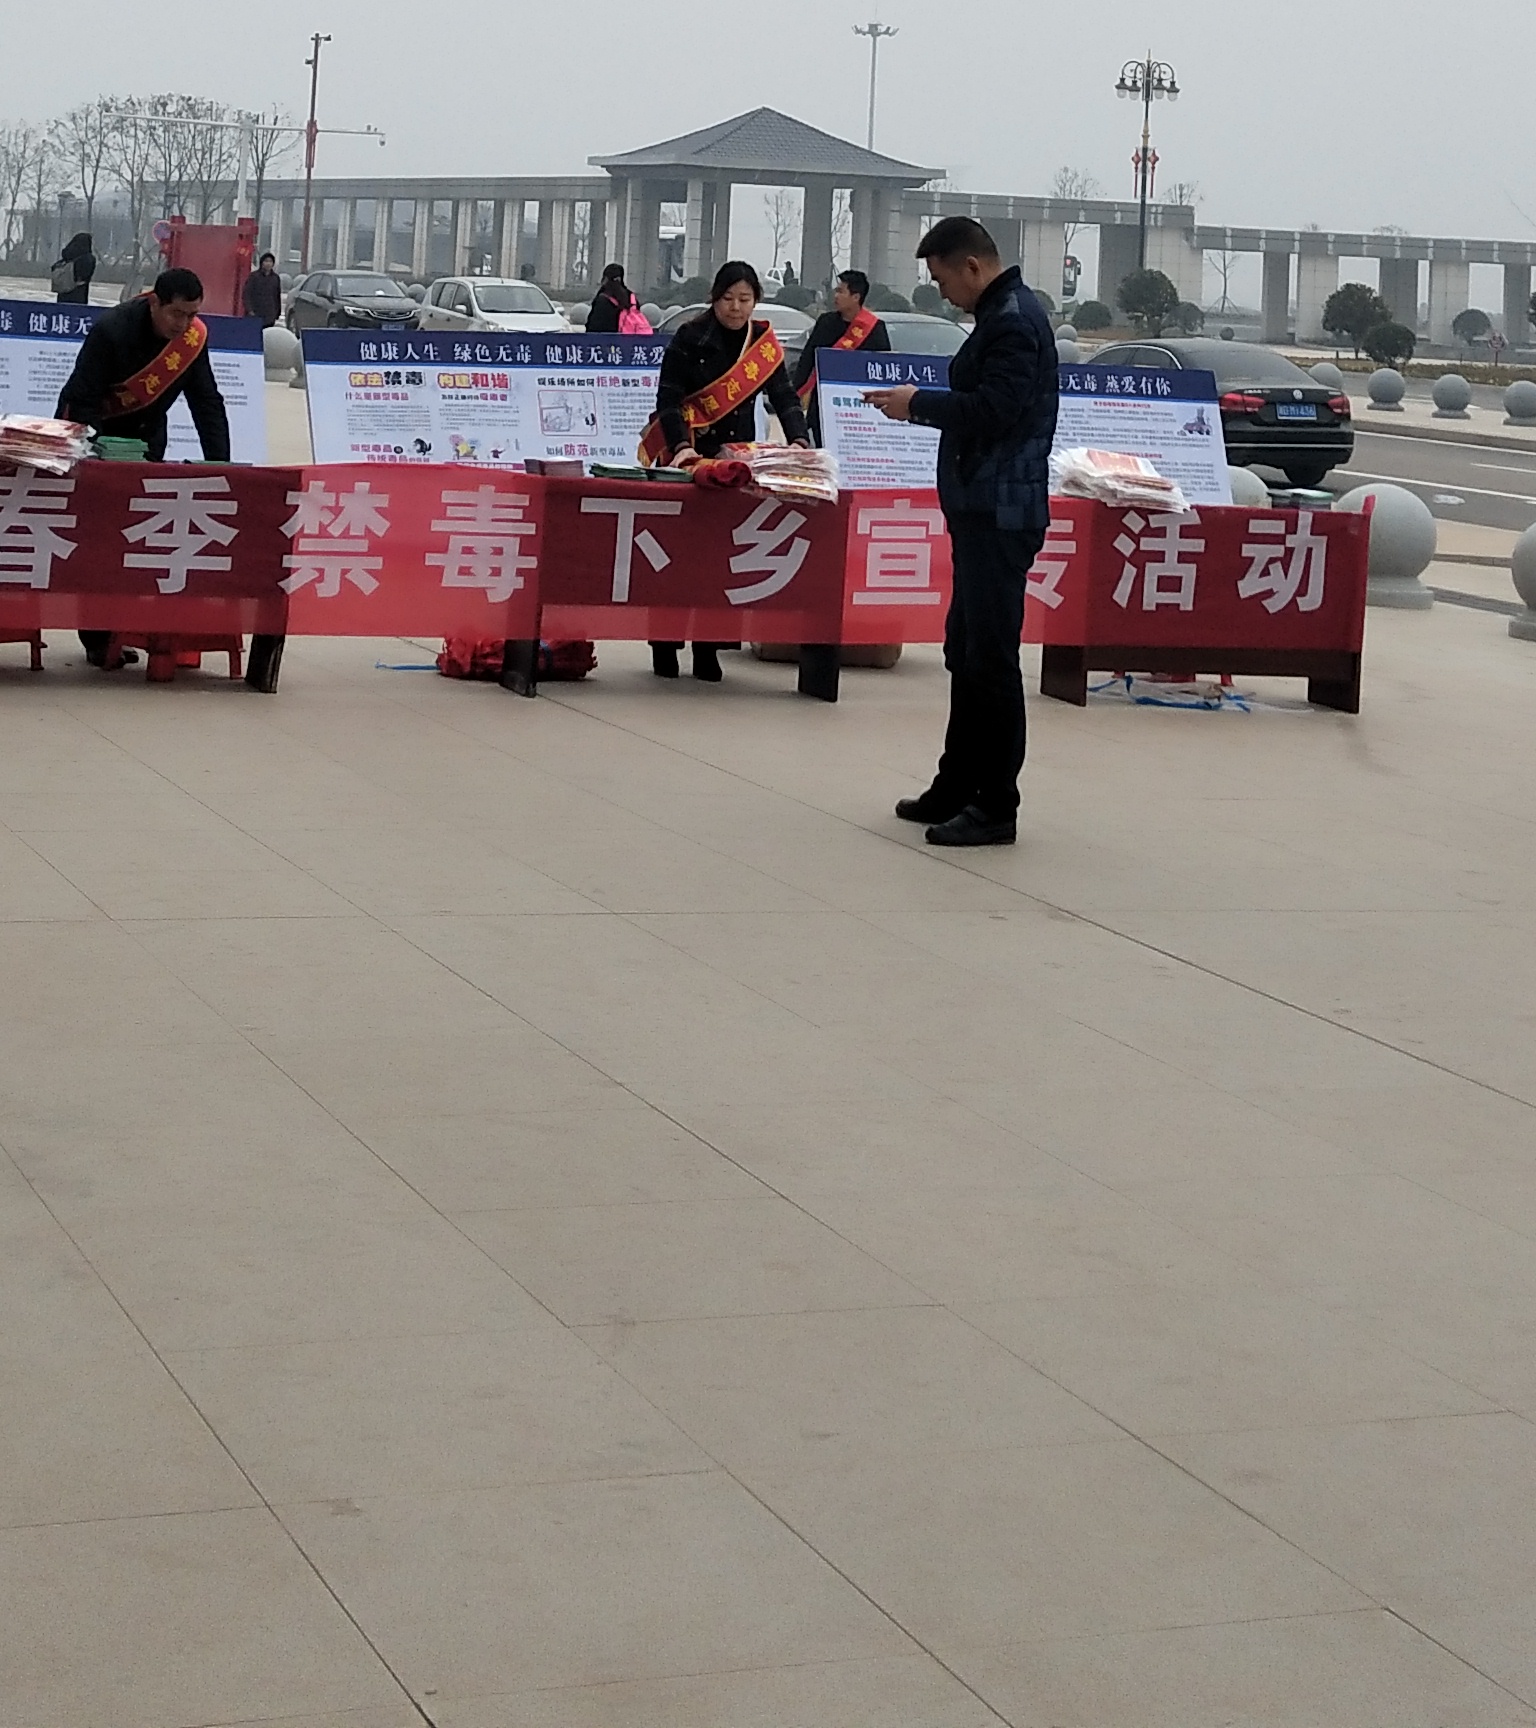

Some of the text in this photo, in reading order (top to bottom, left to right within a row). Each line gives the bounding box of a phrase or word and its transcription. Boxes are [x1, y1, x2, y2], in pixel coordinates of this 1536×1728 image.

[29, 312, 94, 336] 健康无
[359, 341, 665, 366] 健康人生 绿色无毒 健康无毒 蒸爱
[867, 361, 1172, 396] 健康人生 无毒 蒸爱有你
